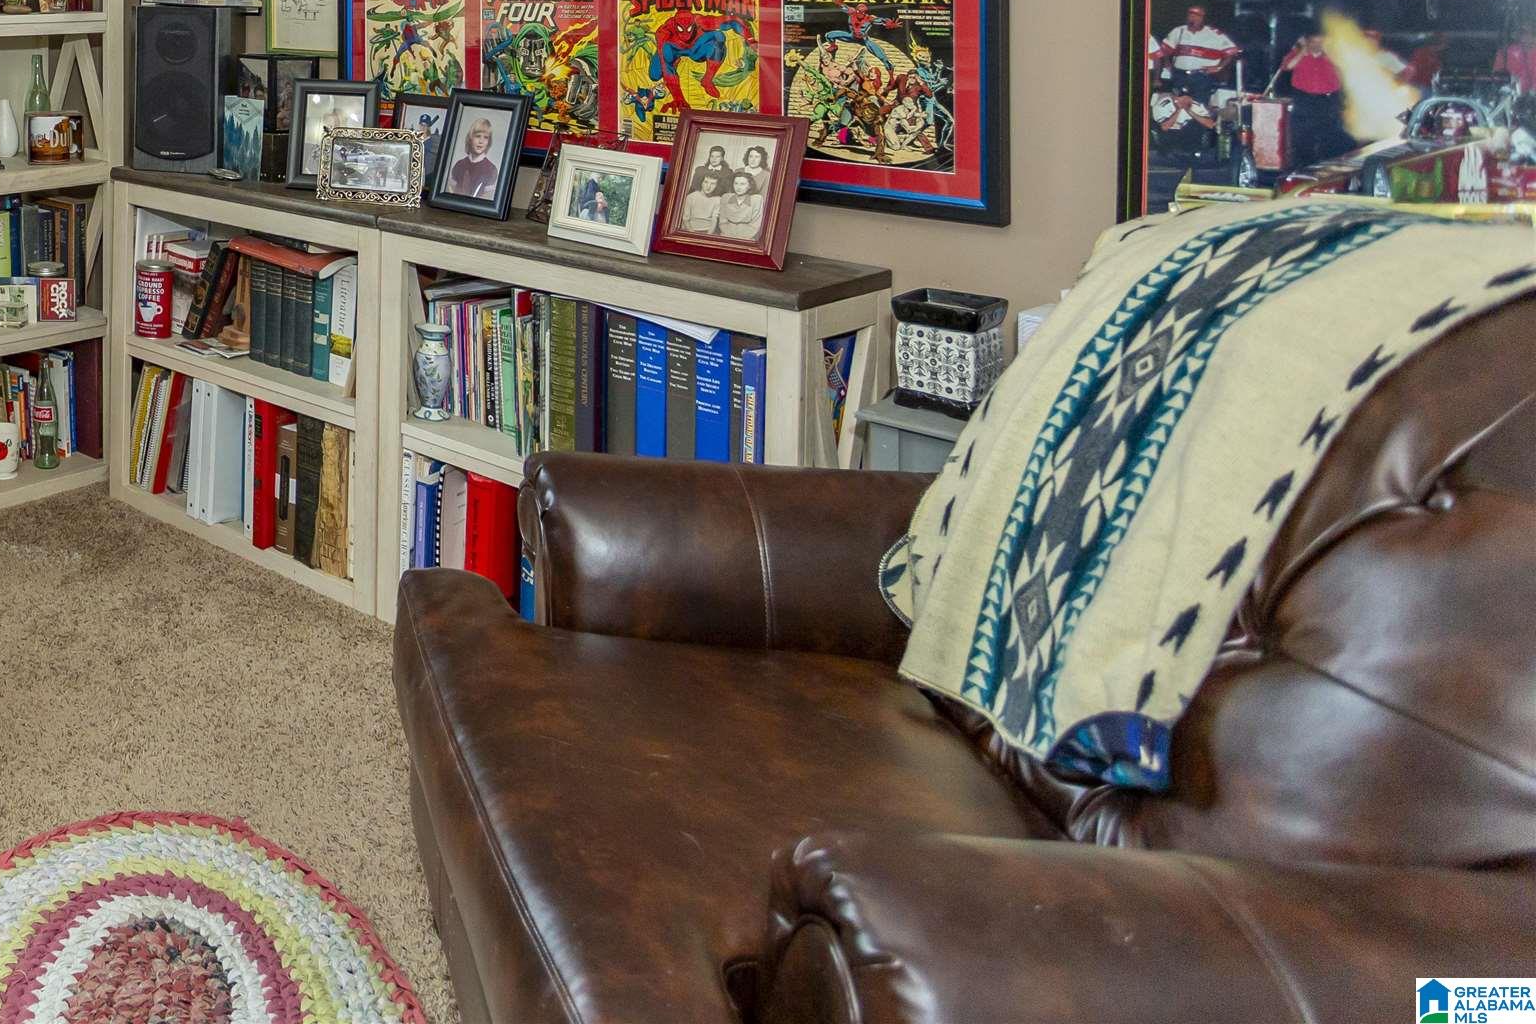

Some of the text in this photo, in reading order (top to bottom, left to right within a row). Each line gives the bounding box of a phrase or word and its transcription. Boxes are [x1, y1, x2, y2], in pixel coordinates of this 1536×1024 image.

[495, 1, 558, 28] FOUR
[49, 284, 59, 316] CITY
[58, 280, 68, 319] ROCK
[338, 279, 351, 335] Literature
